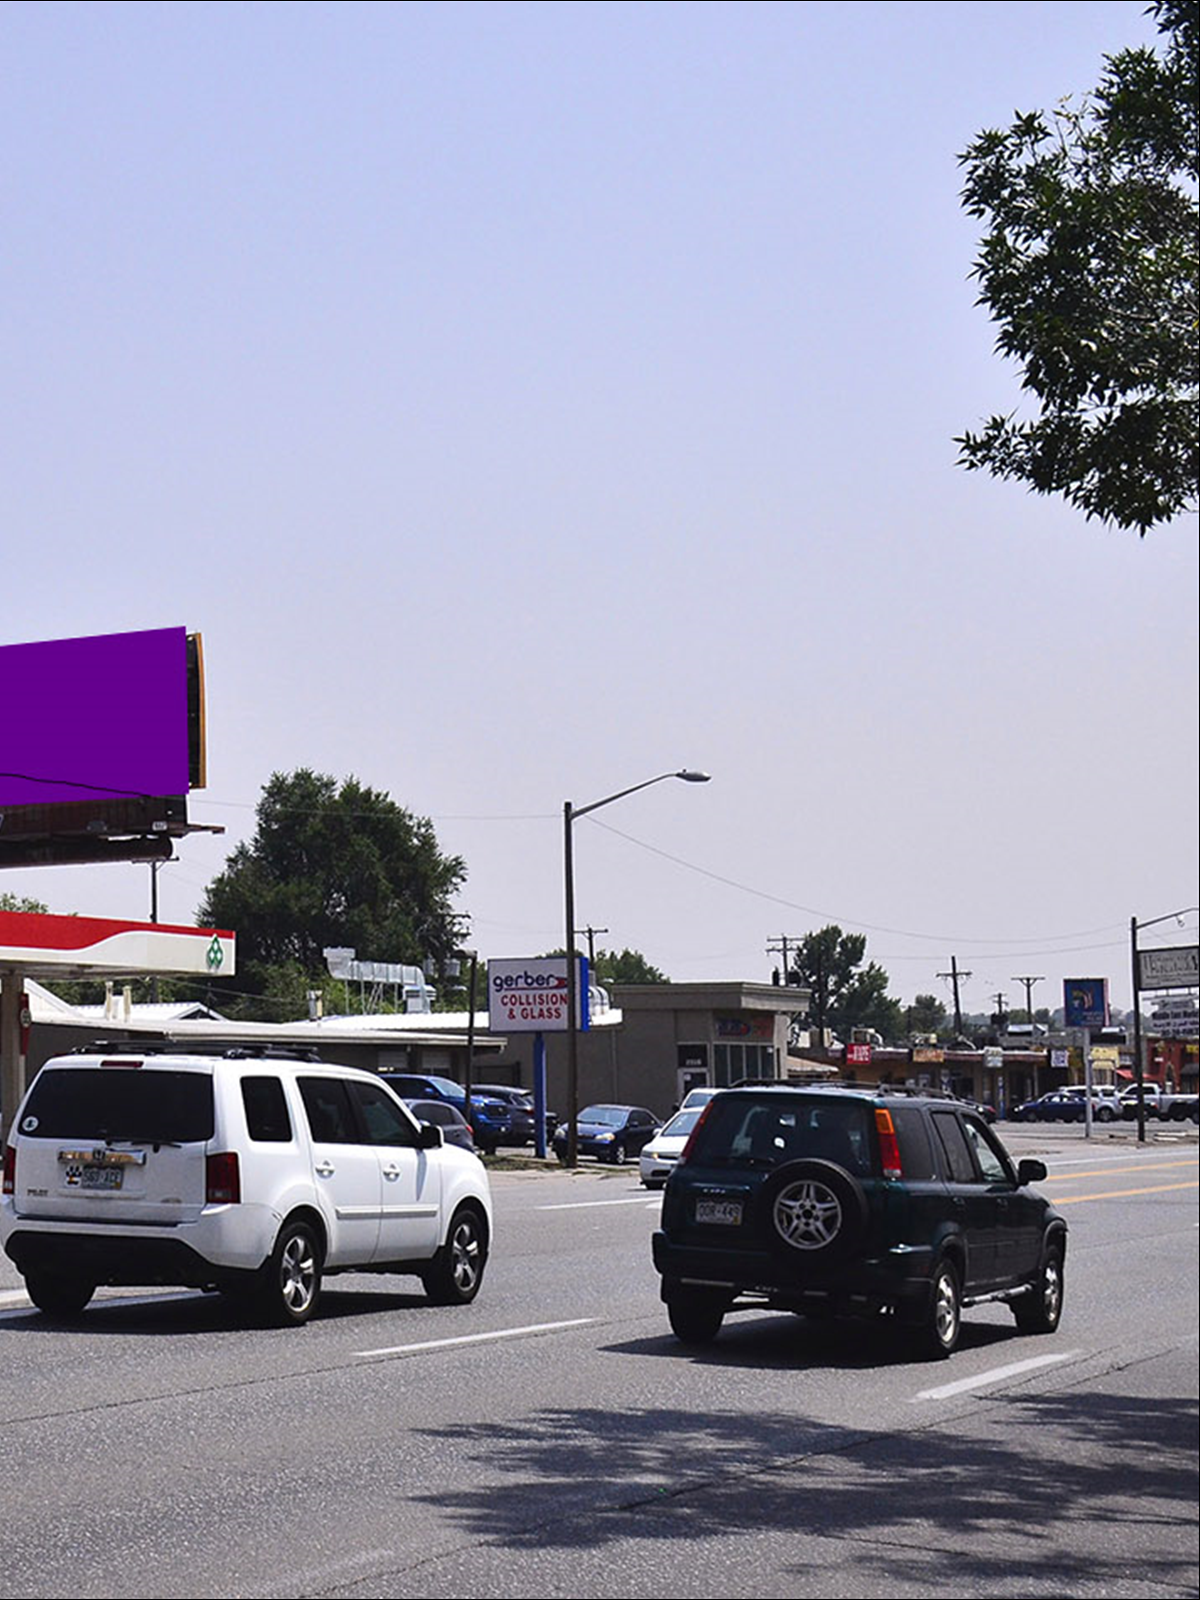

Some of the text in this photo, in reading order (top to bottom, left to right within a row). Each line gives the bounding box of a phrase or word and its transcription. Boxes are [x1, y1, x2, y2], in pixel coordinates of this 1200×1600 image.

[493, 970, 555, 992] gerber
[501, 993, 568, 1007] COLLISION
[508, 1006, 562, 1020] & GLASS
